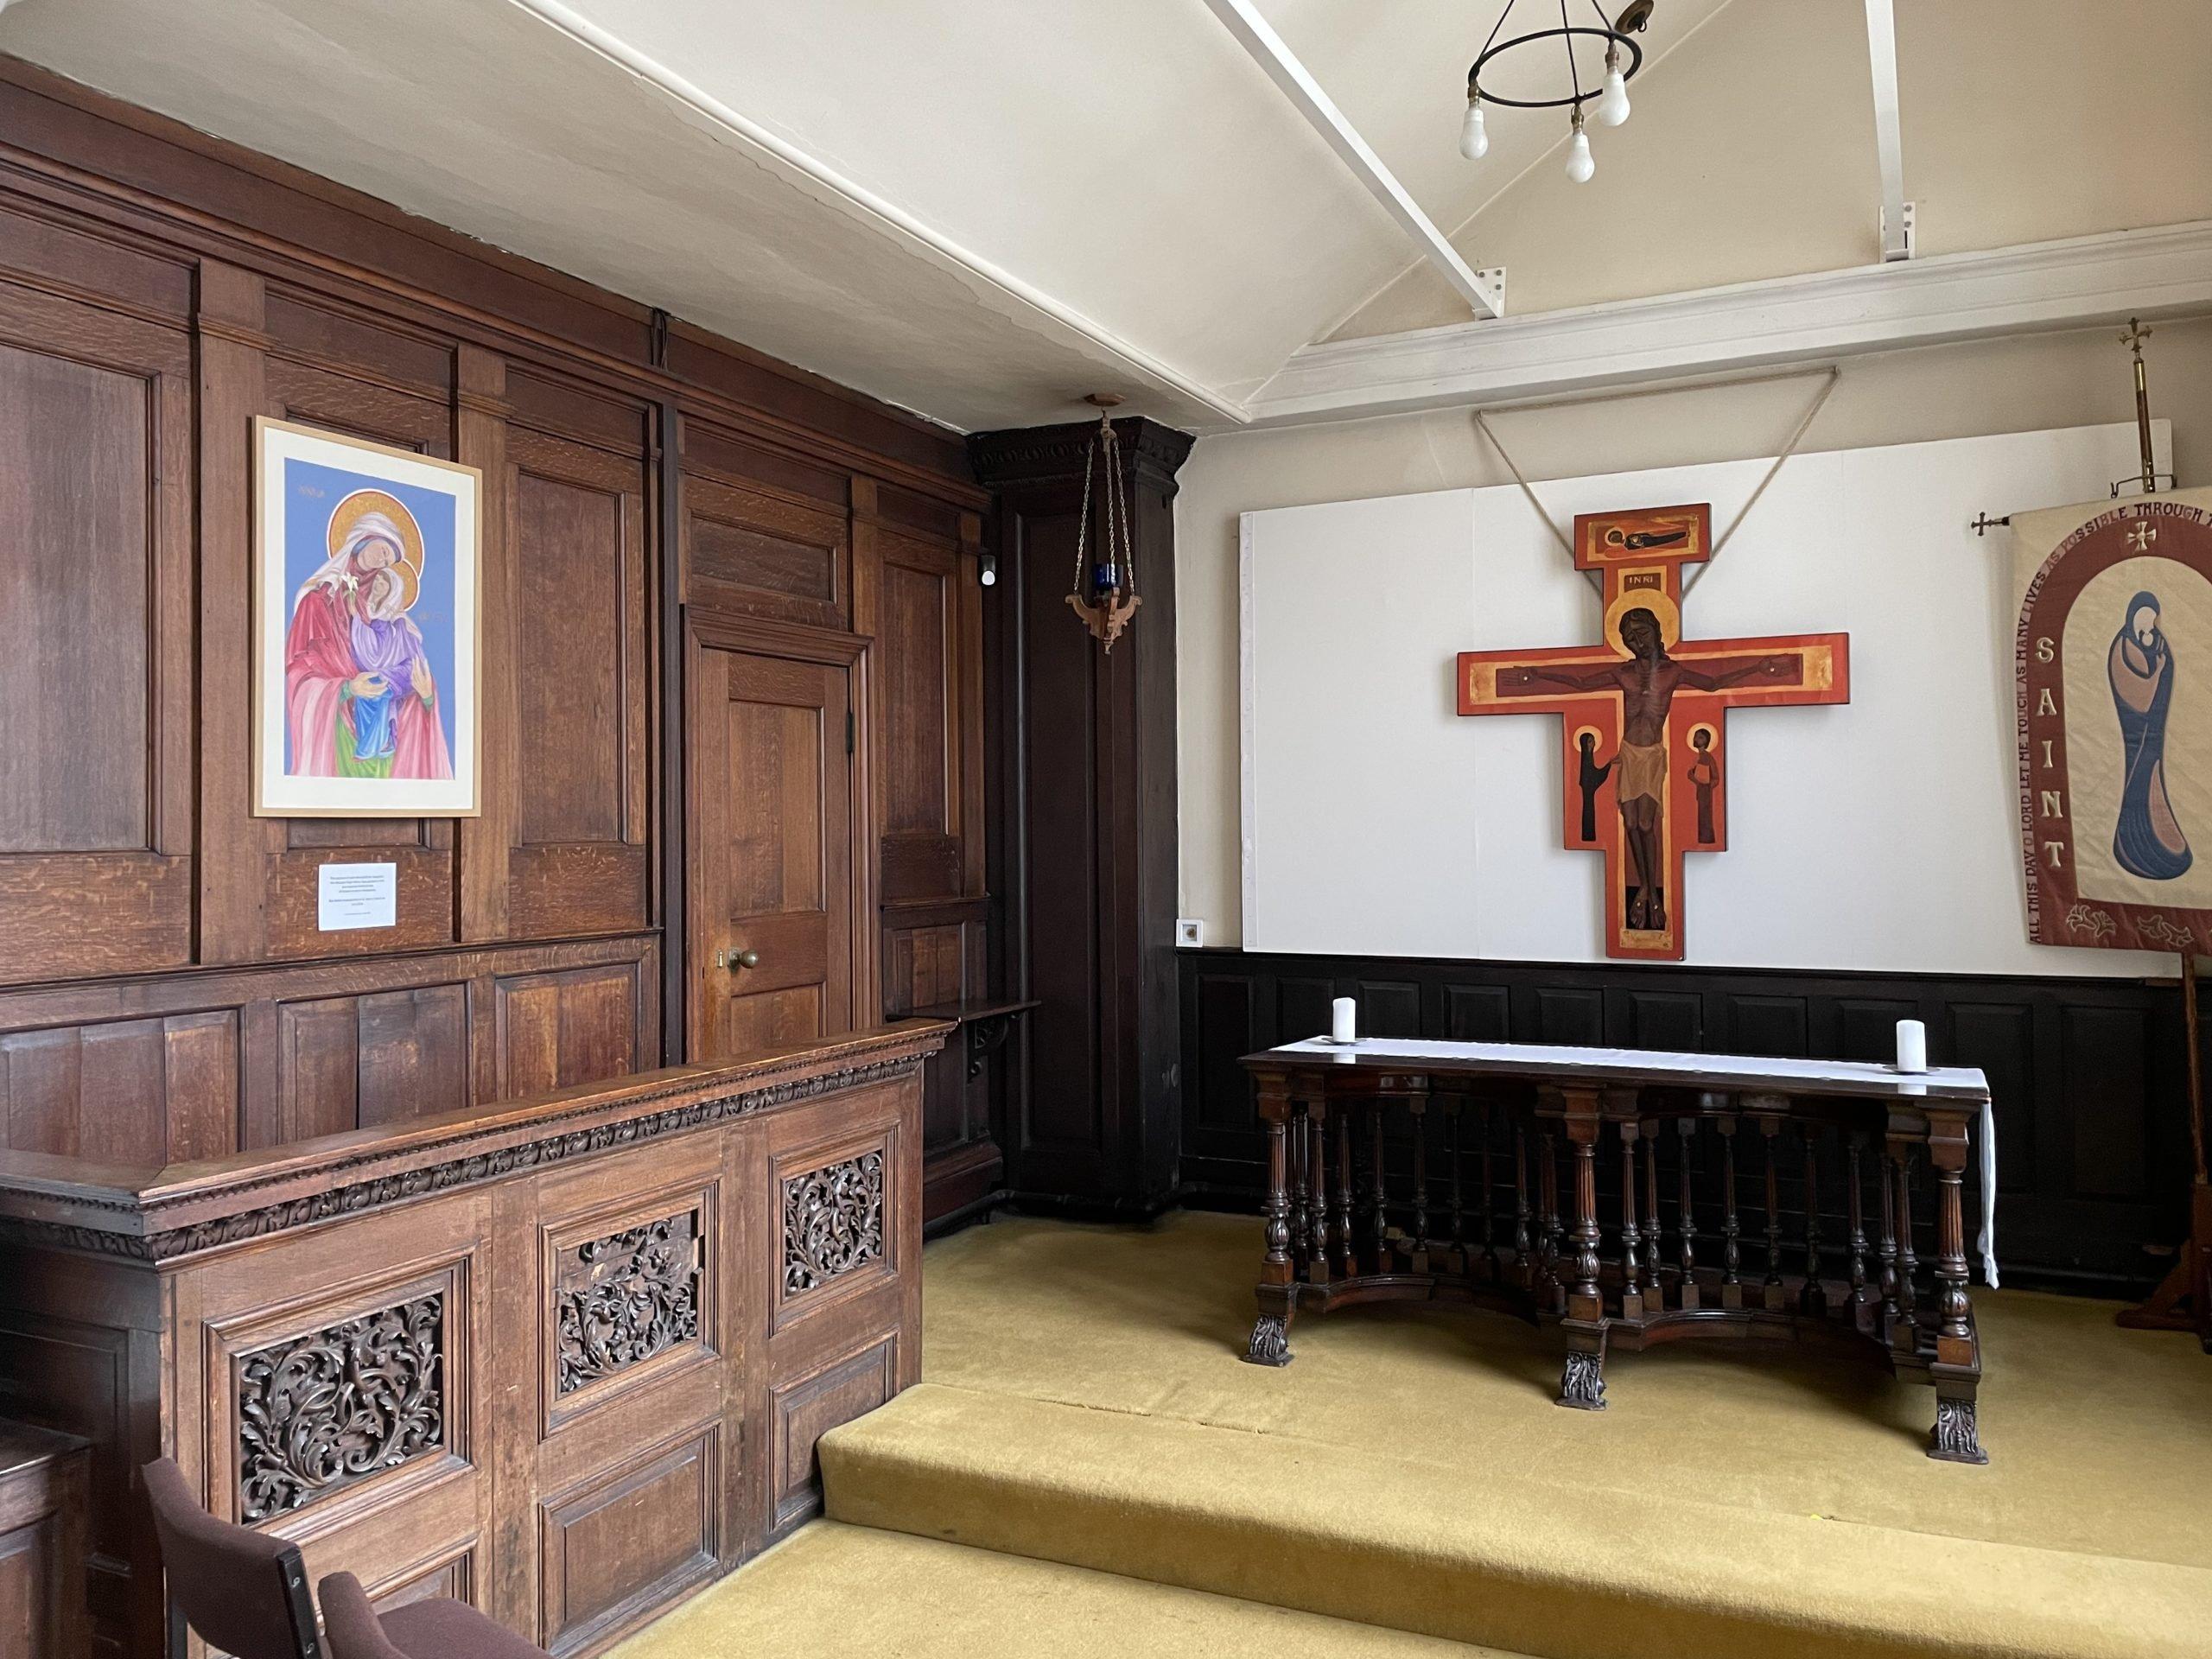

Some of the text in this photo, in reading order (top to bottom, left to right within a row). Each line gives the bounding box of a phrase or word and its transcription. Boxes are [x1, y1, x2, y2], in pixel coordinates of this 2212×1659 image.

[2134, 501, 2203, 522] THROUGH
[2060, 506, 2128, 551] POSSIBLE
[2045, 552, 2061, 571] AS
[1629, 575, 1654, 584] INRI
[2022, 571, 2046, 613] LIVES
[2016, 617, 2029, 660] MANY
[2016, 666, 2027, 684] AS
[2018, 691, 2029, 737] TOUCH
[2018, 742, 2031, 761] ME
[2020, 766, 2031, 789] LET
[2021, 795, 2033, 831] LORD
[2024, 849, 2037, 876] DAY
[2026, 883, 2039, 913] THIS
[2029, 918, 2041, 944] ALL
